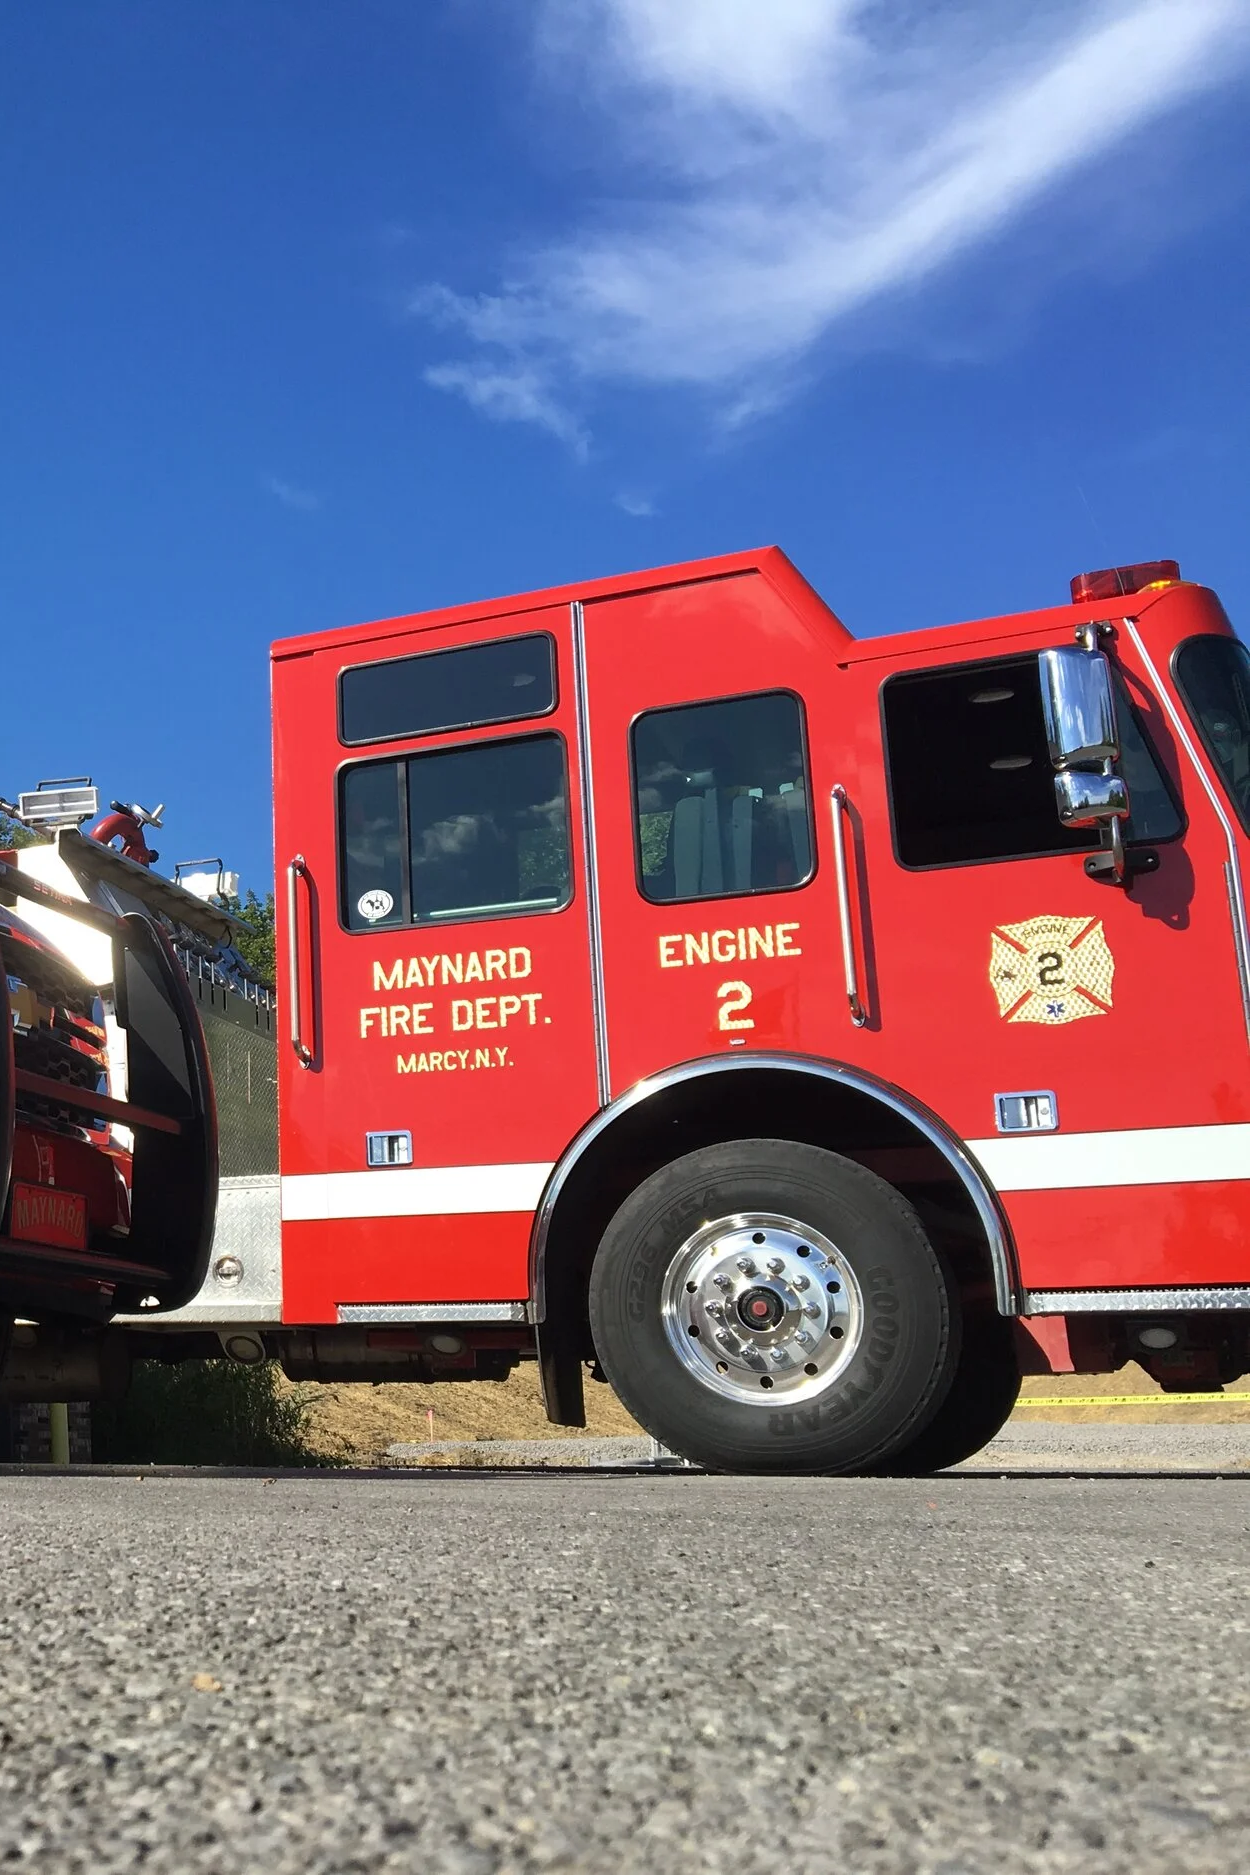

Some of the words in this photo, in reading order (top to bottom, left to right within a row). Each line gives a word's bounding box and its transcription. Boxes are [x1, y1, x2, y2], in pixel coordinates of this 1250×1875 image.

[659, 923, 802, 968] ENGINE
[373, 947, 532, 991] MAYNARD
[1038, 951, 1065, 986] 2
[360, 1002, 434, 1038] FIRE
[451, 993, 552, 1032] DEPT.
[717, 981, 755, 1031] 2
[16, 1196, 84, 1239] MAYNARD
[767, 1265, 900, 1437] GOODYEAR
